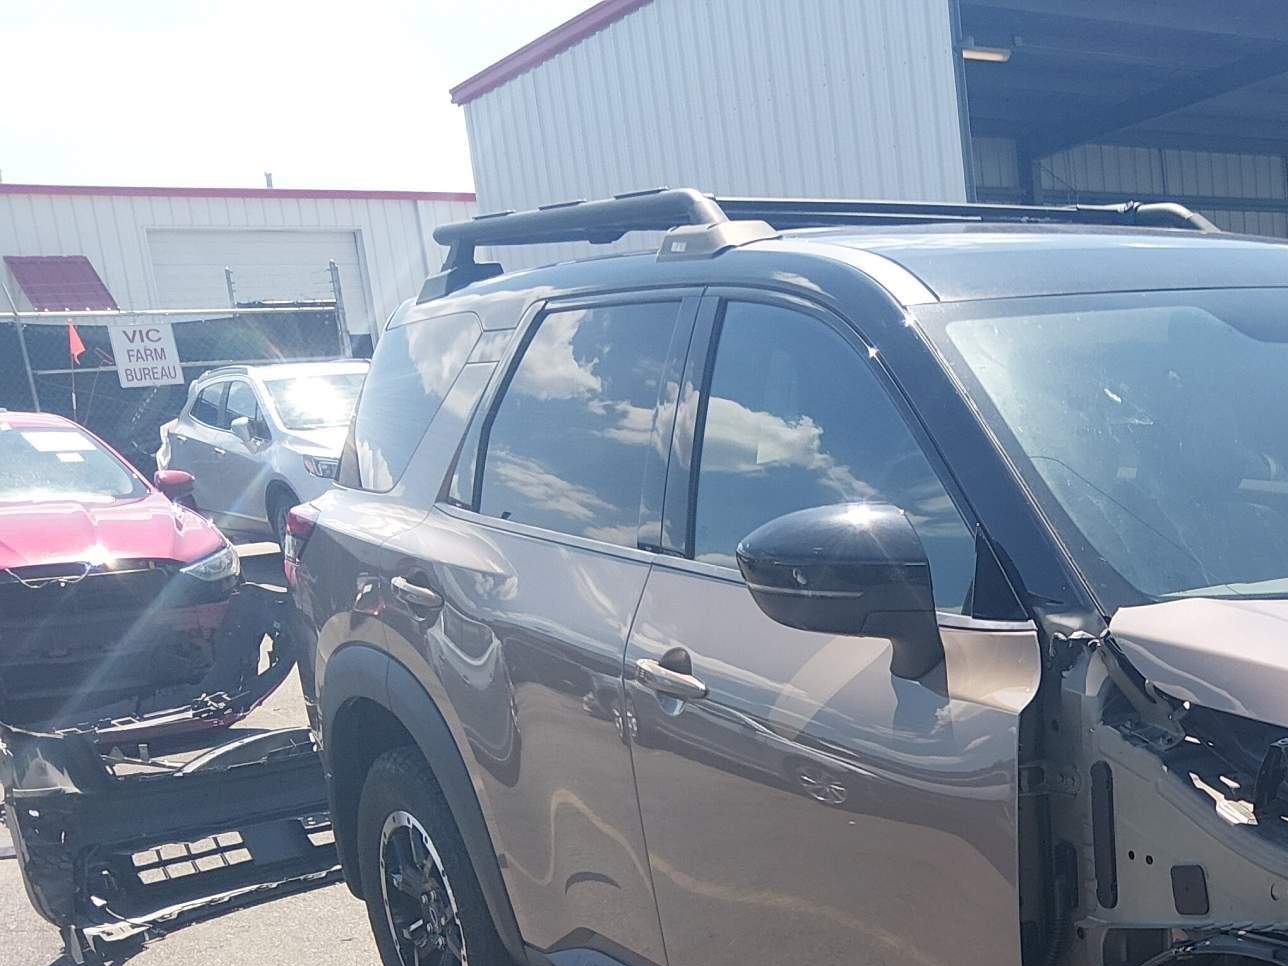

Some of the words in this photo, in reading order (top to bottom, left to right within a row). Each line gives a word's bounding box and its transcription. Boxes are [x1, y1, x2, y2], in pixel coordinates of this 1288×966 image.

[122, 328, 162, 343] VIC
[127, 347, 167, 362] FARM
[125, 366, 177, 381] BUREAU
